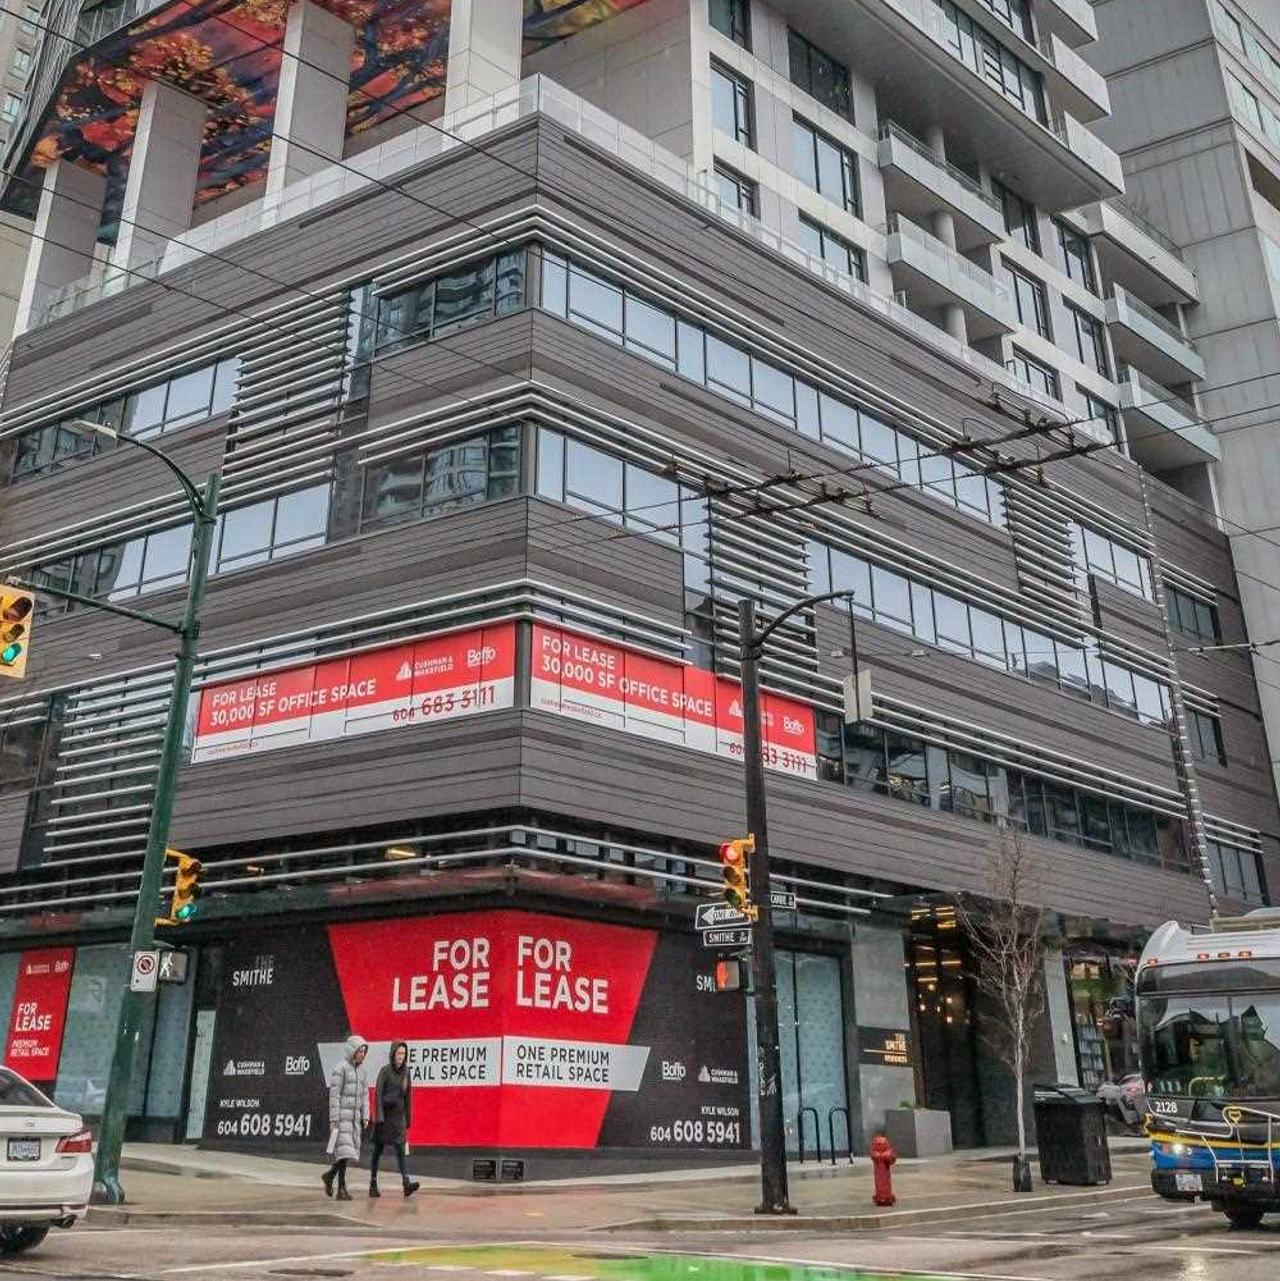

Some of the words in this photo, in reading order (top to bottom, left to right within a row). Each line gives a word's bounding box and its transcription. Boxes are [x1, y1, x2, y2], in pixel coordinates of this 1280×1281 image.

[543, 635, 571, 657] FOR
[574, 646, 615, 670] LEASE
[213, 688, 236, 707] FOR
[239, 681, 277, 703] LEASE
[542, 657, 594, 686] 30,000
[598, 671, 615, 688] SF
[619, 678, 669, 705] OFFICE
[671, 692, 713, 718] SPACE
[209, 706, 255, 726] 30,000
[258, 701, 275, 718] SF
[278, 688, 326, 712] OFFICE
[331, 678, 377, 703] SPACE
[421, 692, 455, 716] 683
[460, 685, 496, 709] 3111
[782, 752, 807, 773] 3111
[708, 932, 735, 943] SMITHE
[432, 937, 490, 971] FOR
[518, 935, 572, 972] FOR
[232, 968, 274, 986] SMITHE
[392, 971, 490, 1012] LEASE
[516, 970, 609, 1014] LEASE
[18, 1002, 38, 1016] FOR
[15, 1014, 52, 1032] LEASE
[286, 1056, 310, 1073] Boffo
[422, 1046, 487, 1063] PREMIUM
[516, 1044, 545, 1062] ONE
[550, 1047, 610, 1066] PREMIUM
[408, 1065, 435, 1081] AIL
[440, 1064, 486, 1080] SPACE
[516, 1063, 563, 1080] RETAIL
[568, 1065, 609, 1083] SPACE
[662, 1061, 686, 1078] Boffo
[1155, 1101, 1178, 1113] 2128
[217, 1120, 238, 1136] 604
[240, 1113, 271, 1135] 608
[274, 1114, 312, 1136] 5941
[650, 1126, 671, 1141] 604
[673, 1120, 703, 1142] 608
[706, 1121, 740, 1144] 5941
